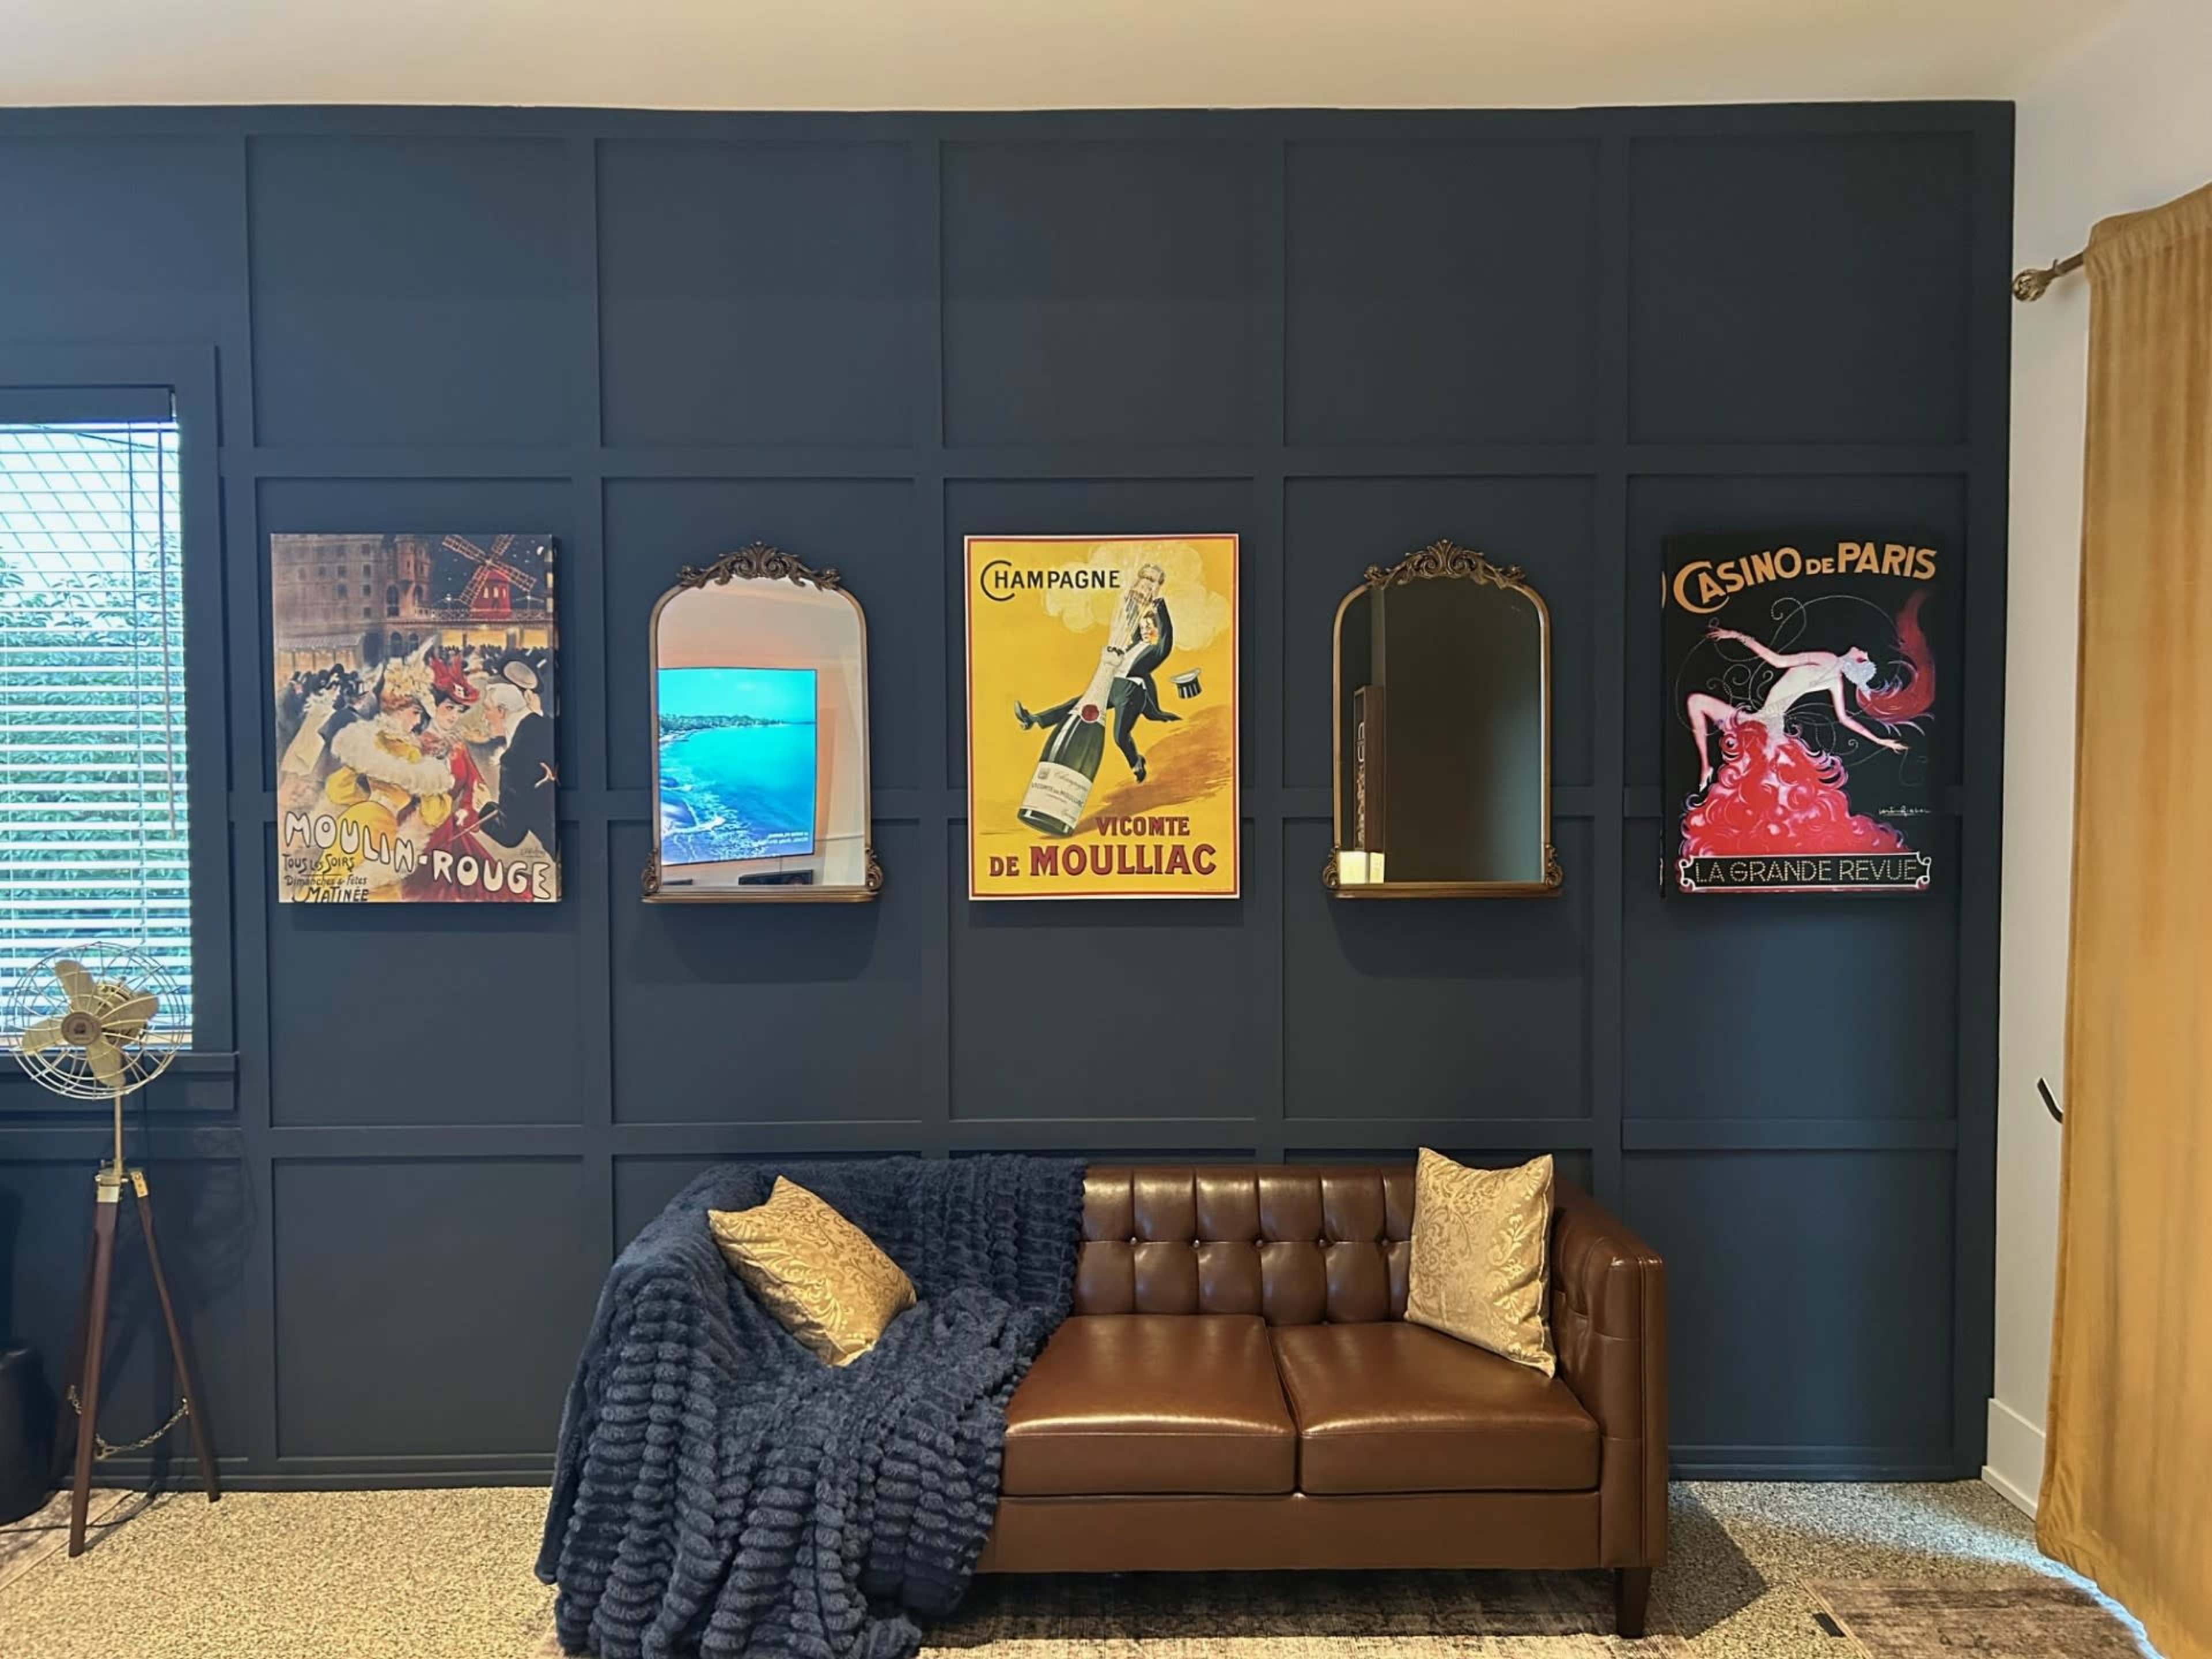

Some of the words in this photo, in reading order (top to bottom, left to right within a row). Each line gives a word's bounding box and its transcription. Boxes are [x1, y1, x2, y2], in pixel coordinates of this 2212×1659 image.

[980, 559, 1120, 601] CHAMPAGNE
[1673, 547, 1802, 614] CASINO
[1805, 558, 1835, 575] DE
[1838, 542, 1937, 580] PARIS
[1096, 816, 1190, 836] VICOMTE
[989, 856, 1020, 876] DE
[1029, 844, 1217, 876] MOULLIAC
[1695, 862, 1725, 883] LA
[1729, 860, 1832, 882] GRANDE
[1839, 859, 1918, 881] REVUE
